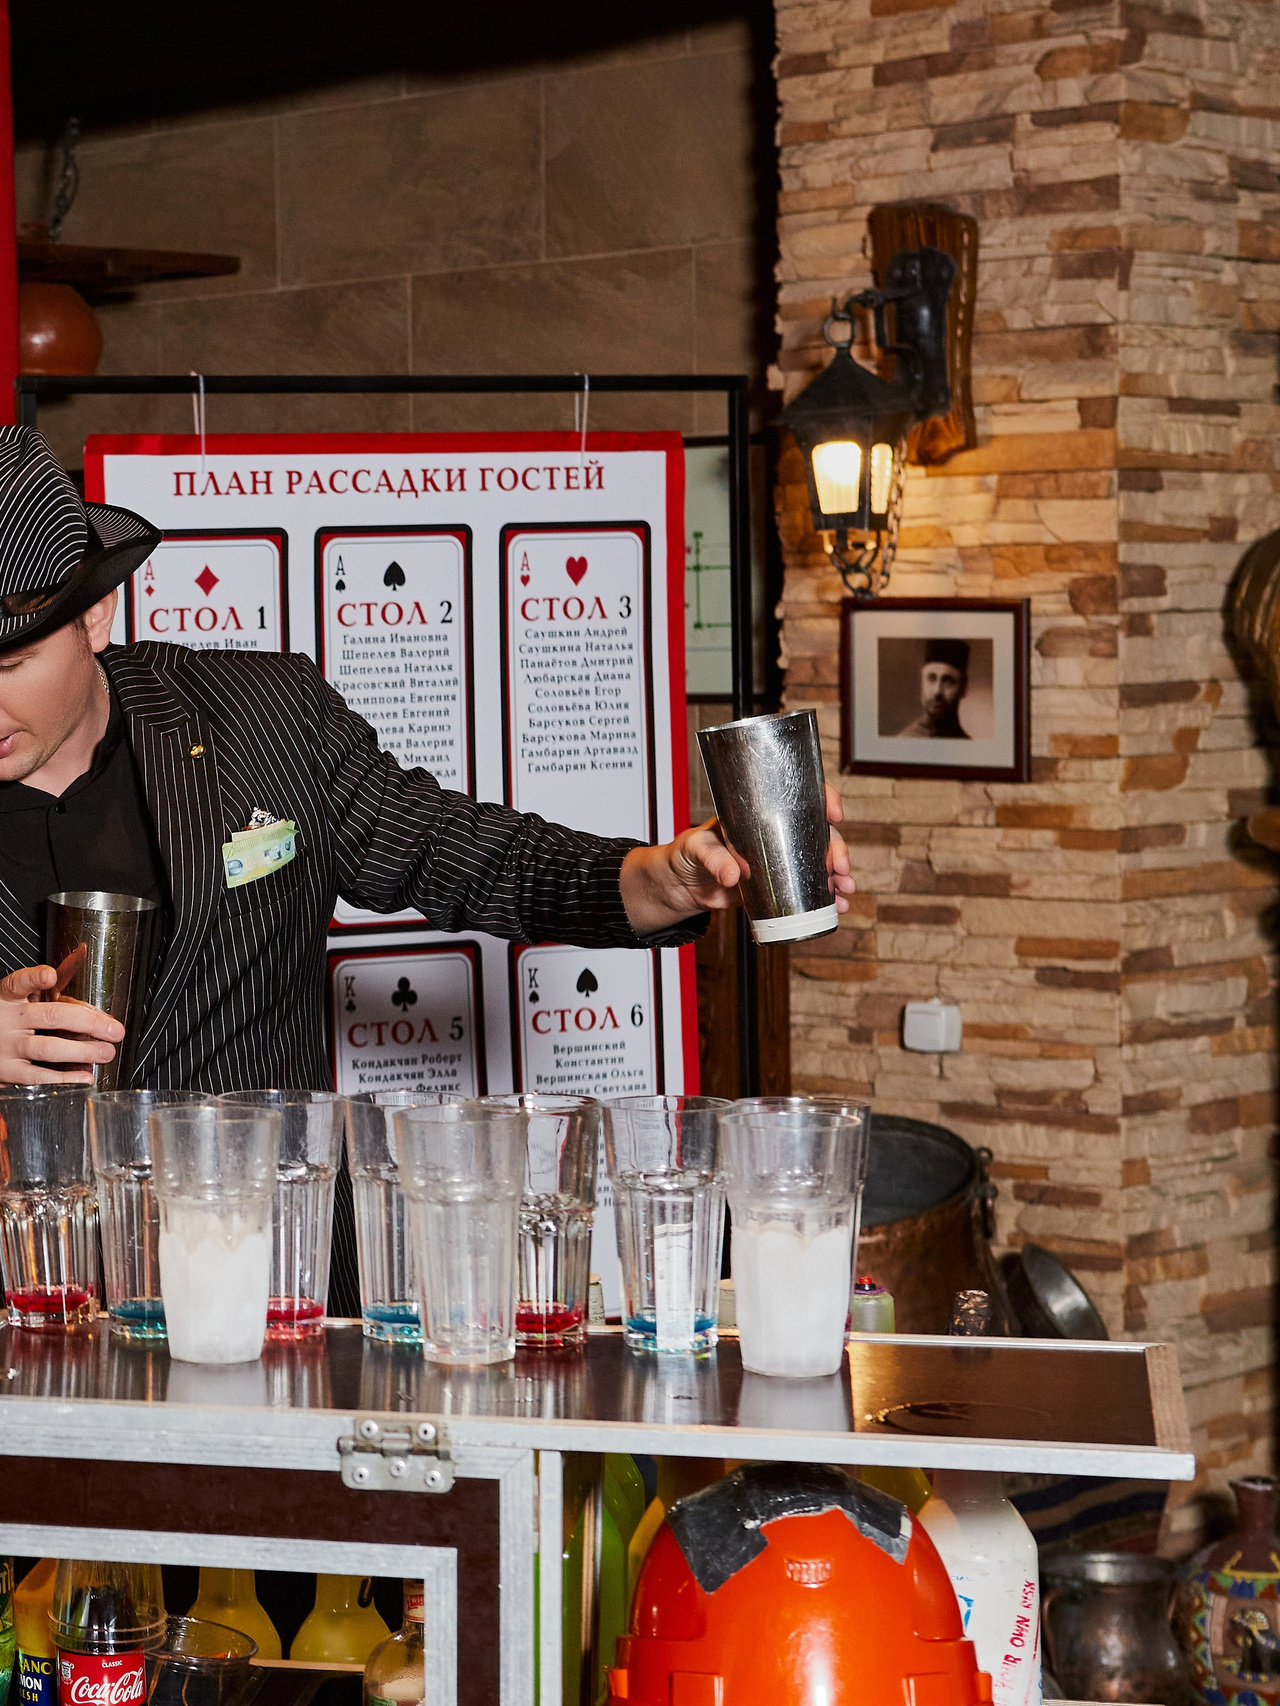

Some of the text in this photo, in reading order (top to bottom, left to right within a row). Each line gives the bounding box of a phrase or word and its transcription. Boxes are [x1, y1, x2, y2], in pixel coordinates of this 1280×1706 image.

[173, 460, 606, 499] ПЛАН РАССАДКИ ГОСТЕЙ
[337, 600, 453, 628] СТОЛ 2
[520, 595, 632, 621] СТОЛ 3
[149, 606, 267, 633] СТОЛ 1
[343, 633, 448, 645] Галина Ивановна
[525, 627, 628, 640] Саушкин Андрей
[225, 638, 257, 649] Иван
[519, 642, 634, 655] Саушкина Наталья
[342, 647, 450, 660] Шепелев Валерий
[581, 656, 634, 668] Дмитрий
[339, 663, 453, 675] Шепелева Наталья
[333, 677, 459, 692] Красовский Виталий
[595, 686, 621, 697] Егор
[347, 693, 457, 705] илиппова Евгения
[595, 701, 629, 711] Юлия
[362, 707, 450, 720] пелев Евгений
[378, 723, 451, 735] лева Каринэ
[529, 715, 630, 730] Барсуков Сергей
[522, 730, 637, 744] Барсукова Марина
[406, 739, 454, 750] Валерия
[404, 753, 450, 764] Михаил
[591, 760, 633, 770] Ксения
[528, 968, 539, 988] K
[344, 976, 356, 998] K
[532, 1003, 643, 1035] СТОЛ 6
[347, 1016, 464, 1048] СТОЛ 5
[553, 1040, 626, 1055] Вершинский
[421, 1053, 462, 1066] Роберт
[555, 1056, 624, 1069] Константин
[427, 1069, 457, 1079] Элла
[536, 1068, 644, 1086] Вершинская Ольга
[594, 1083, 647, 1094] Светлана
[1009, 1614, 1031, 1648] OWN
[101, 1659, 123, 1669] CLASSIC
[20, 1673, 43, 1692] MON
[71, 1667, 144, 1706] Coca-Cola
